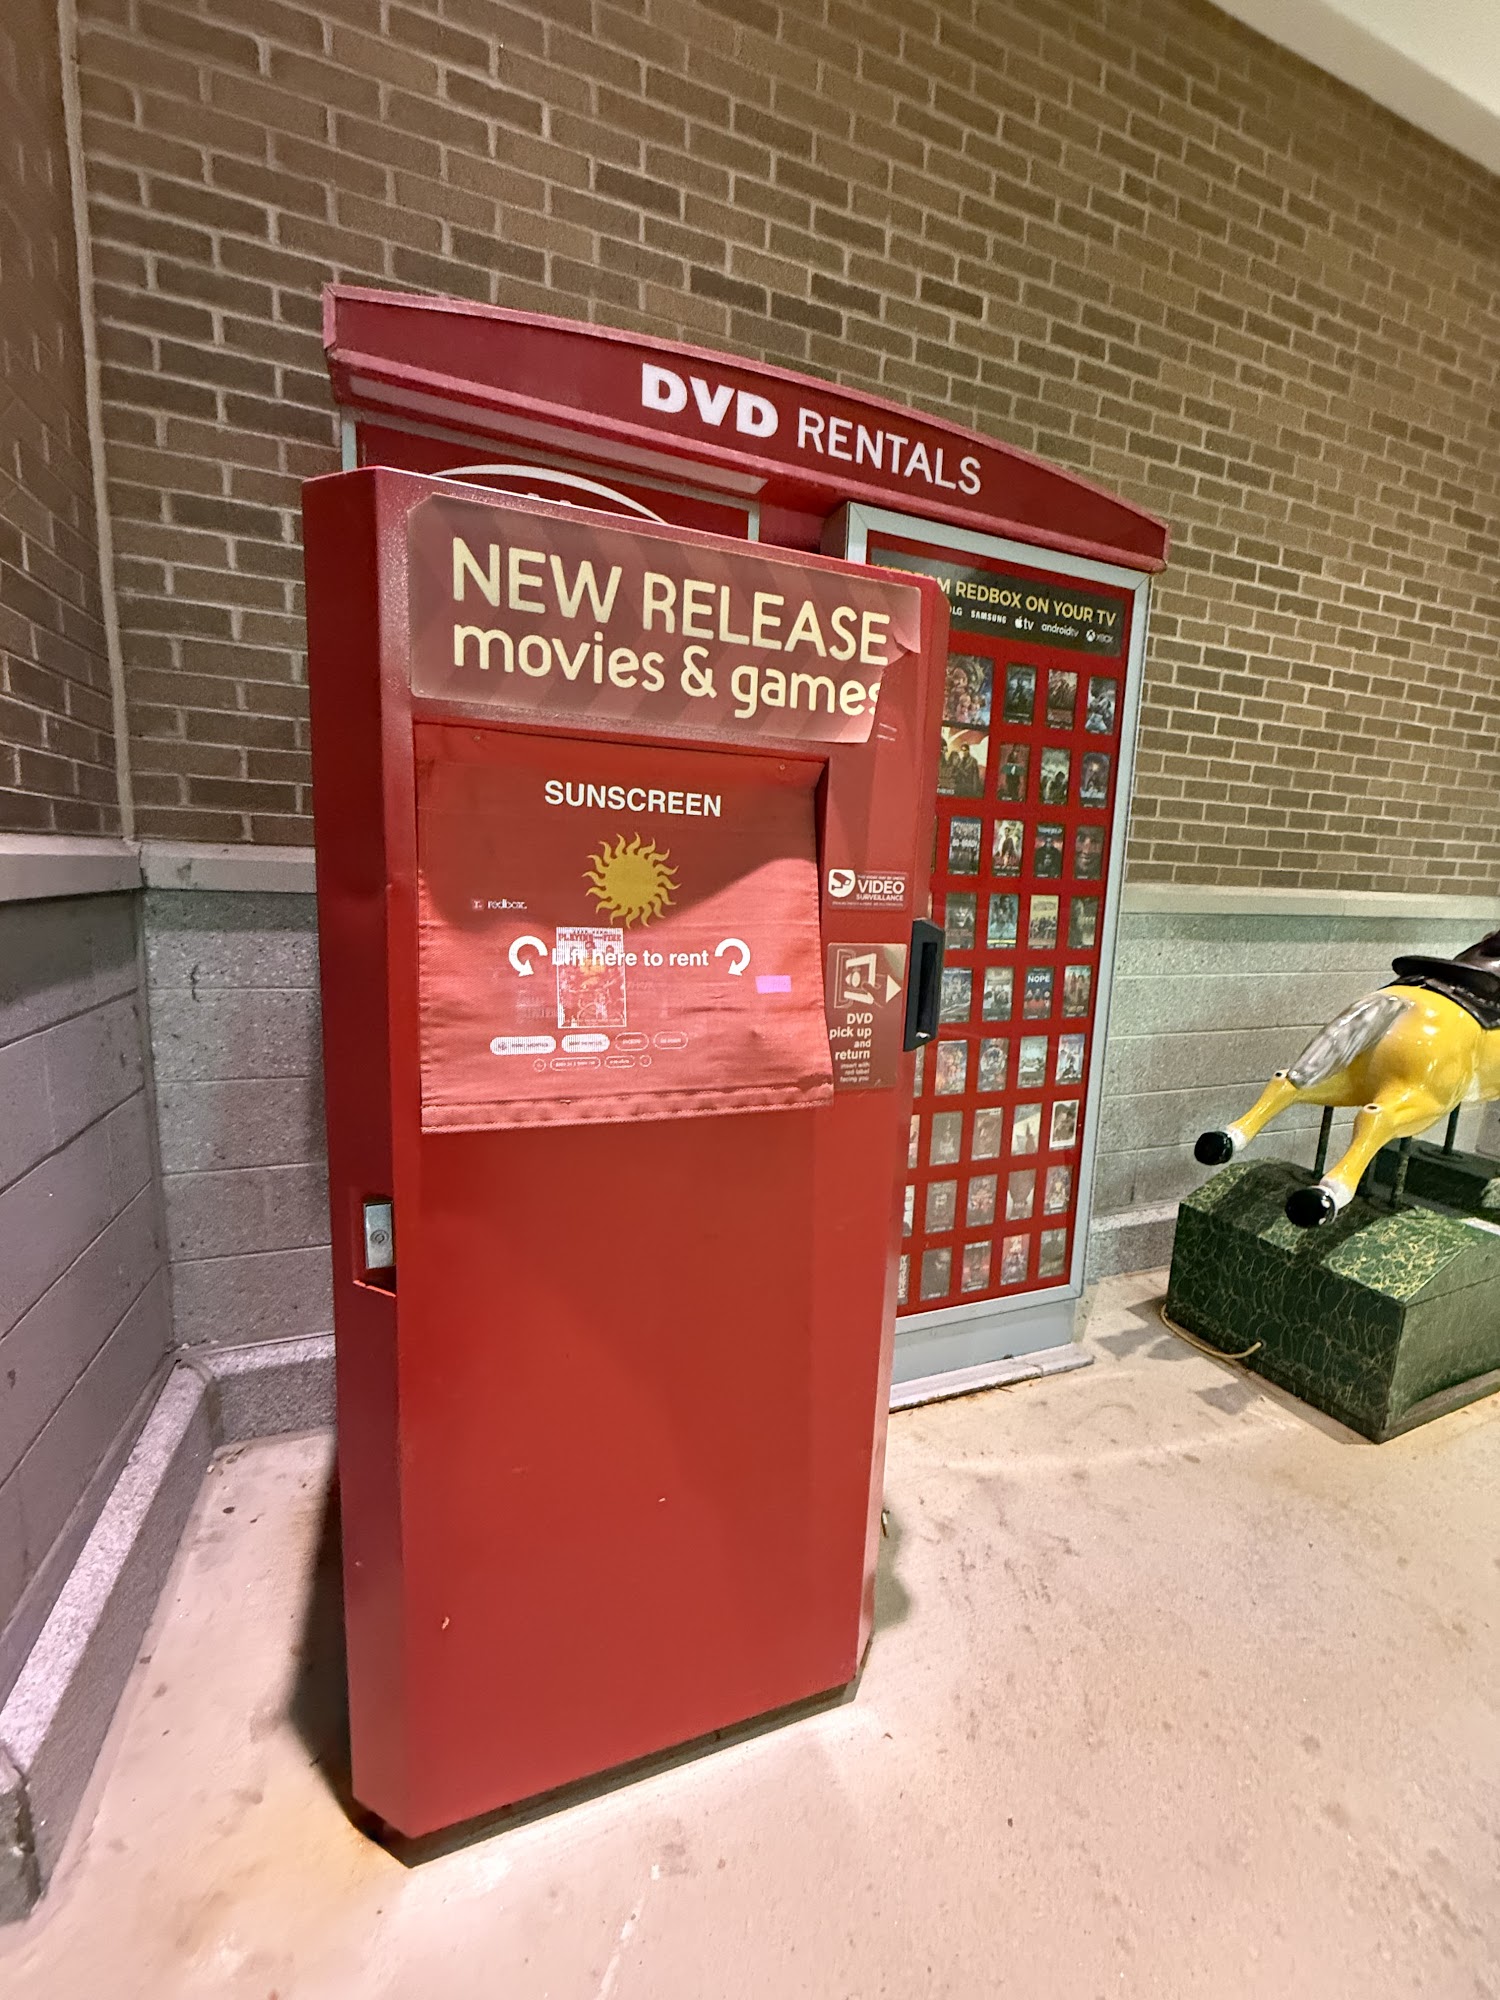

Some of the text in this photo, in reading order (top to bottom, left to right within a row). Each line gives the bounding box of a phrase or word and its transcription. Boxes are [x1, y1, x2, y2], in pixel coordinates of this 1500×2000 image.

[641, 362, 981, 495] DVD RENTALS
[453, 537, 890, 666] NEW RELEASE
[956, 581, 1117, 627] REDBOX ON YOUR TV
[952, 608, 963, 616] LG
[970, 610, 1007, 624] SAMSUNG
[454, 624, 664, 692] movies
[680, 645, 717, 699] &
[544, 780, 722, 817] SUNSCREEN
[857, 879, 905, 895] VIDEO
[856, 893, 904, 902] SURVEILLANCE
[592, 948, 638, 967] here
[643, 949, 664, 967] to
[669, 949, 709, 967] rent
[1027, 975, 1051, 983] NOPE
[846, 1012, 874, 1025] DVD
[829, 1026, 872, 1040] pick up
[853, 1039, 872, 1049] and
[834, 1048, 870, 1061] return
